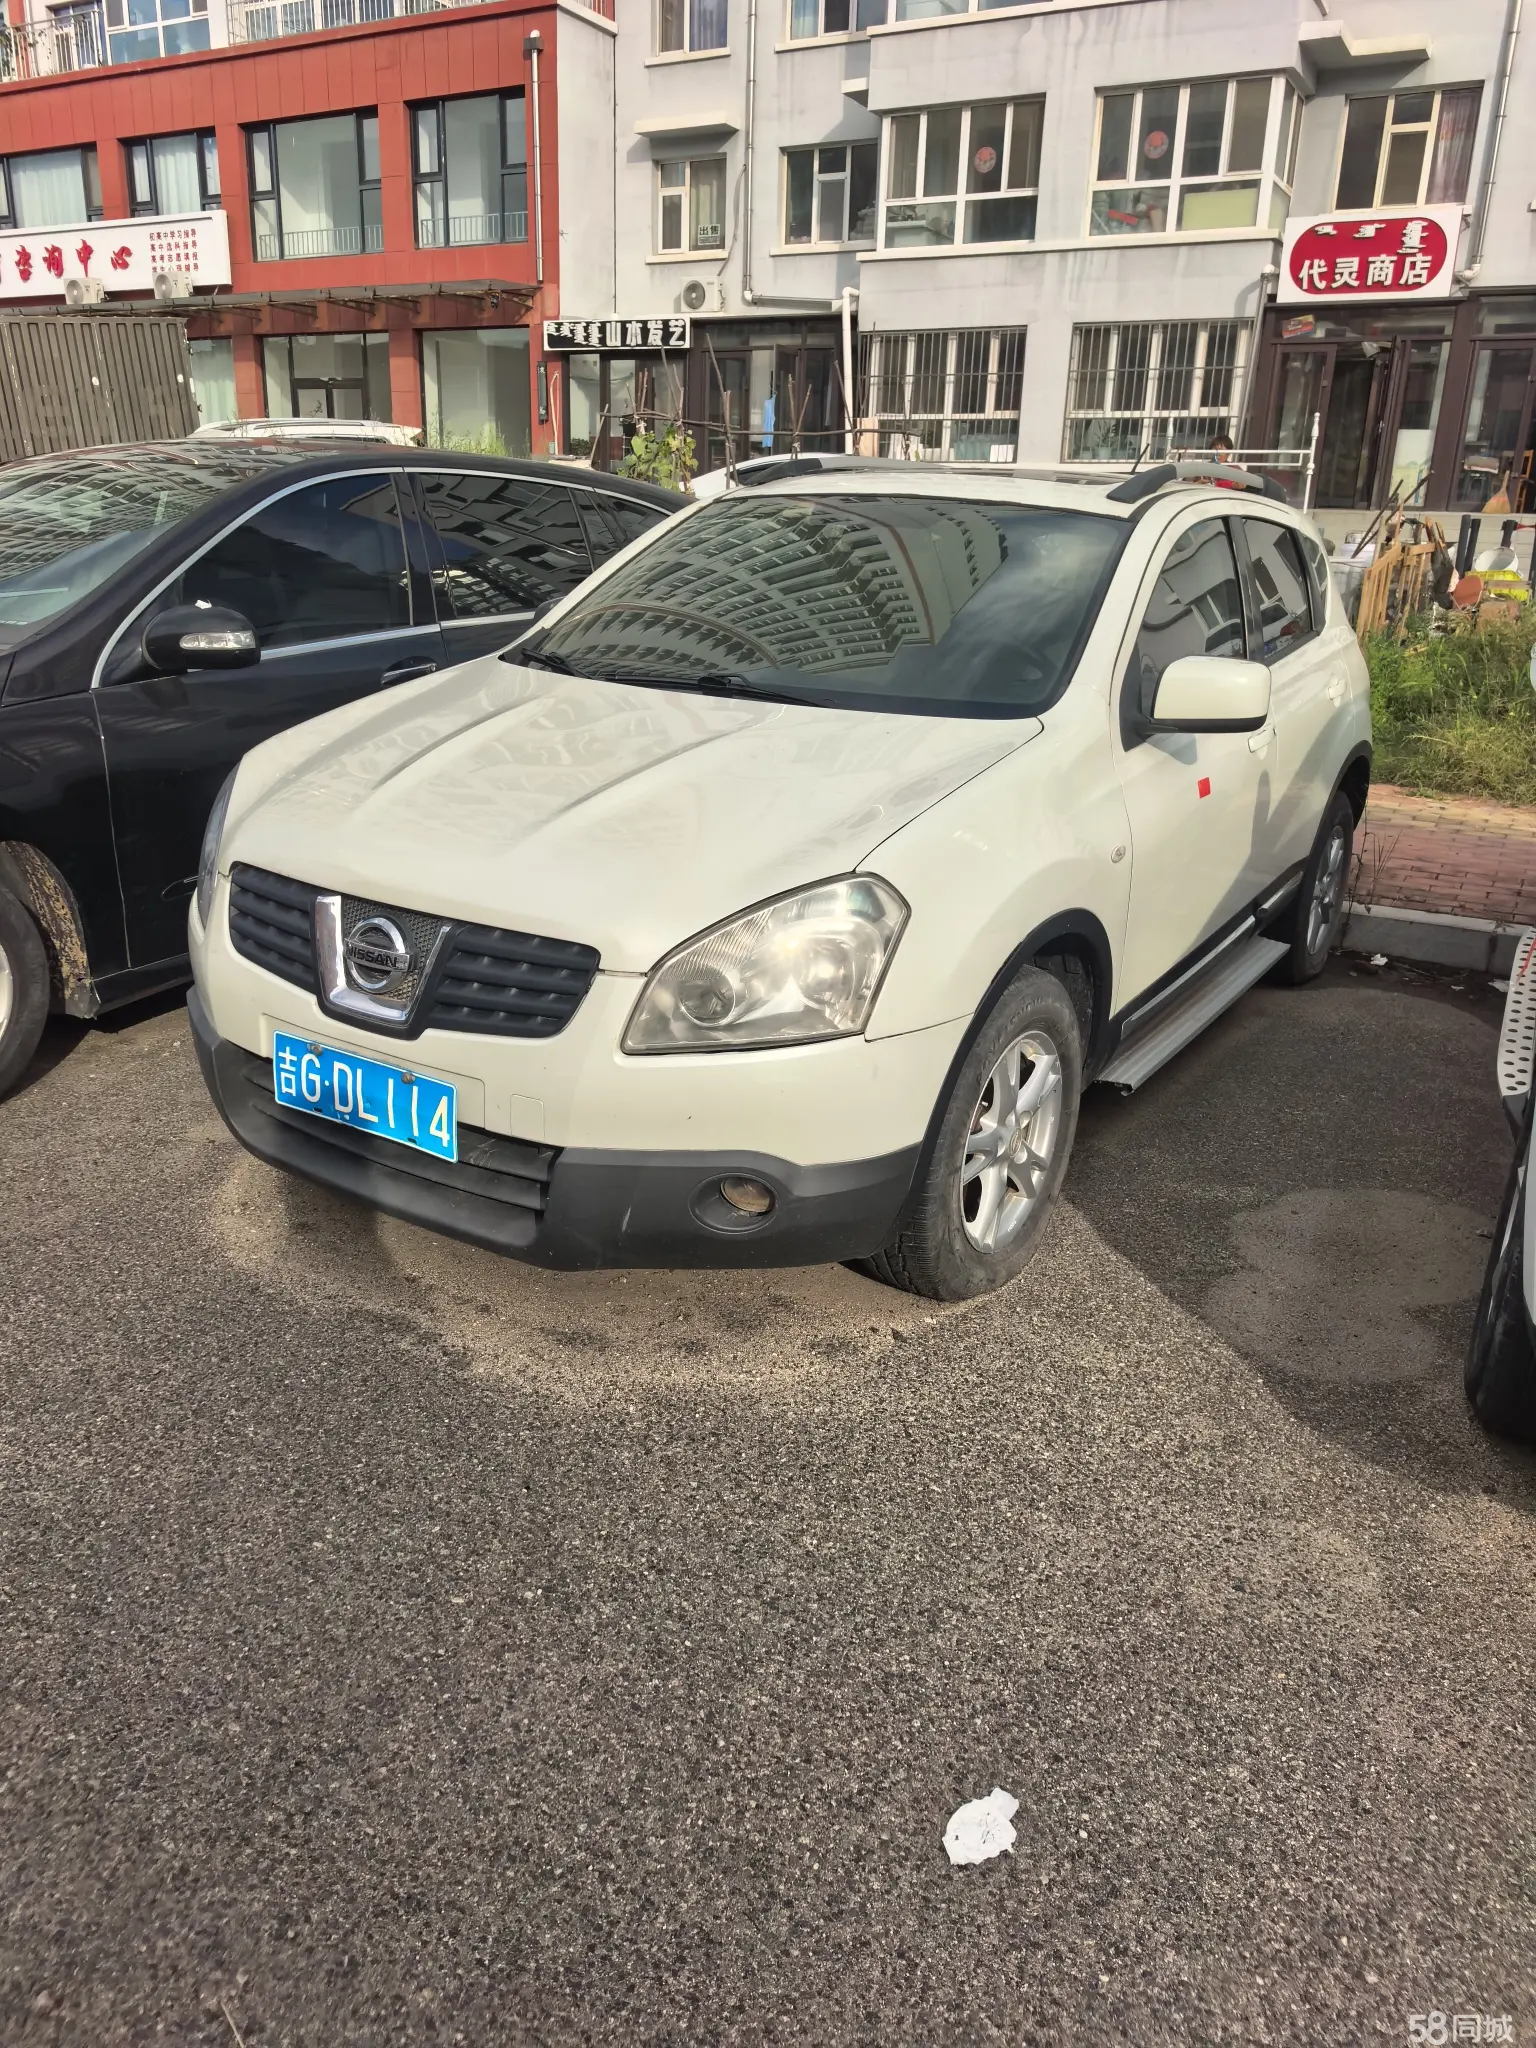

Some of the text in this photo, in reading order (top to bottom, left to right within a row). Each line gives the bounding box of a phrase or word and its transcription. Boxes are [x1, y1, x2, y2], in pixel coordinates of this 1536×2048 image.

[0, 238, 133, 283] 咨询中心
[1299, 253, 1432, 290] 代灵商店
[346, 943, 398, 968] NISSAN
